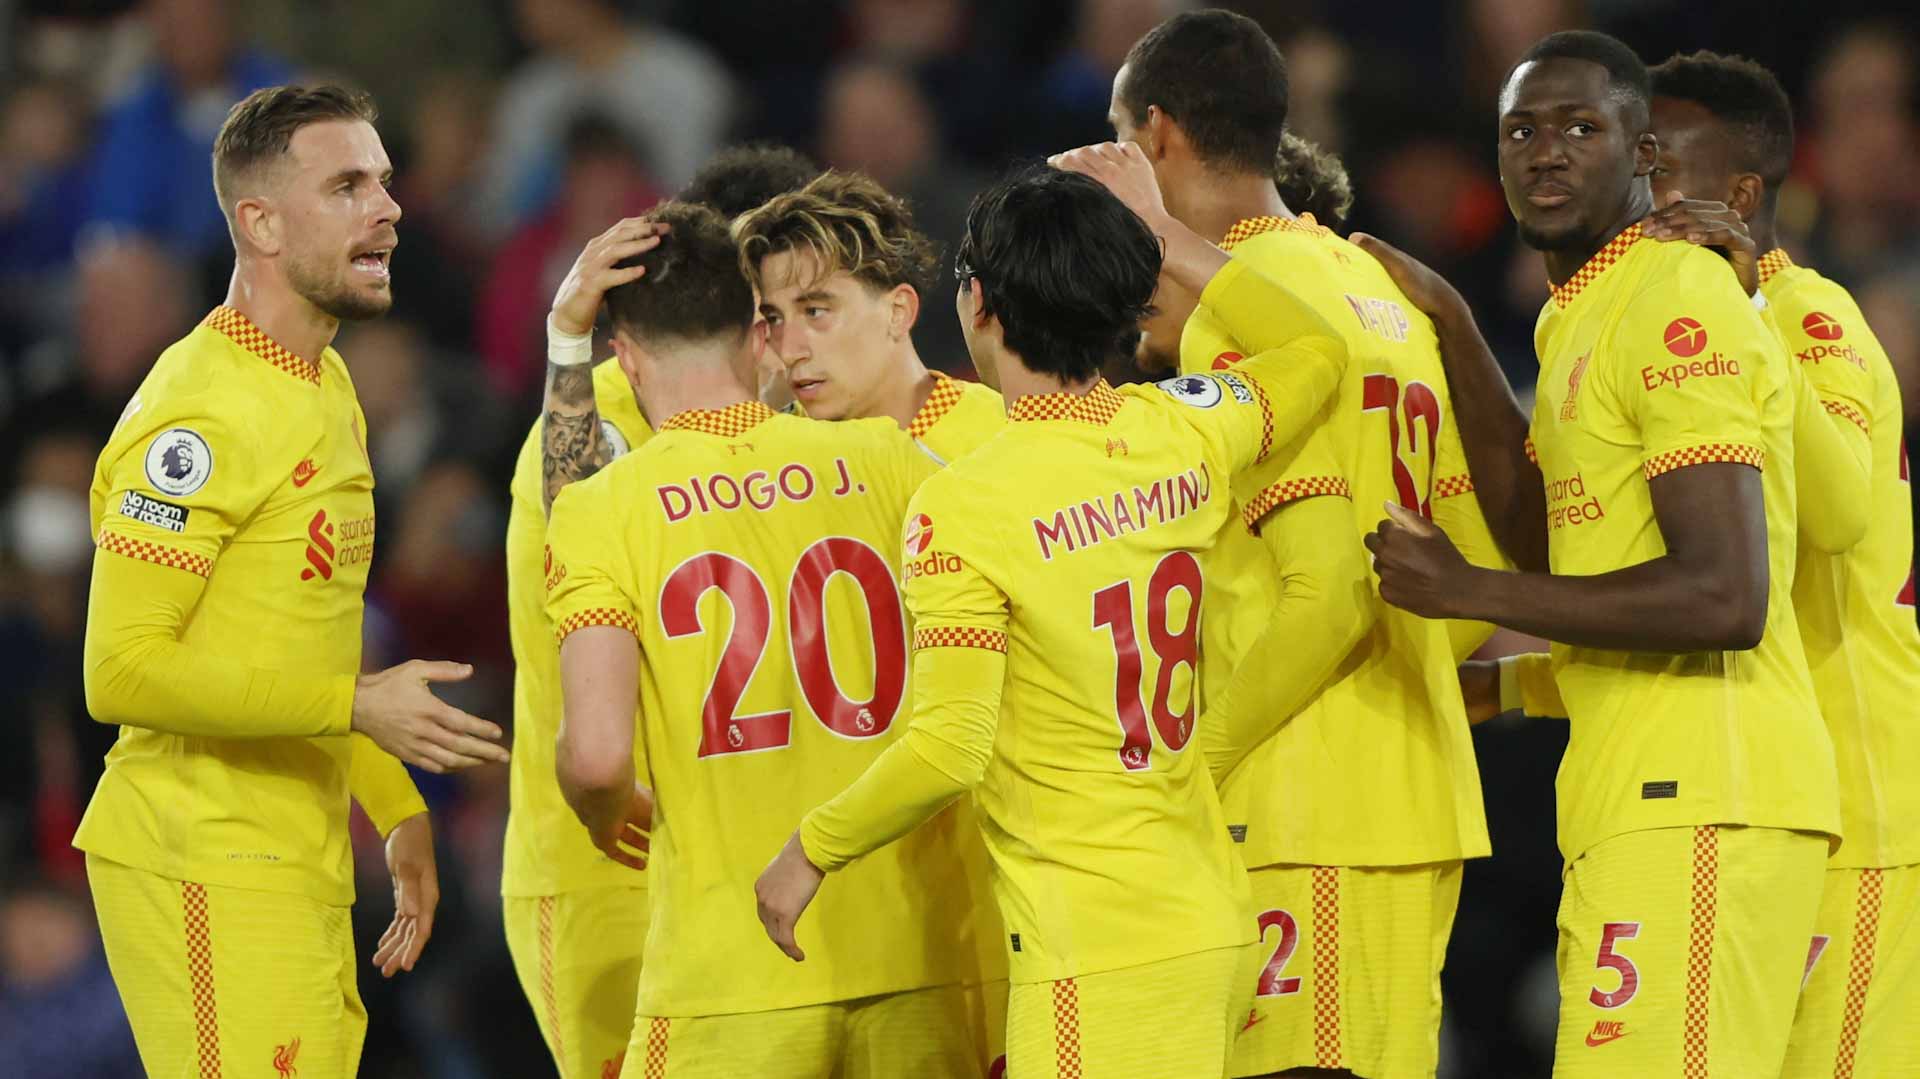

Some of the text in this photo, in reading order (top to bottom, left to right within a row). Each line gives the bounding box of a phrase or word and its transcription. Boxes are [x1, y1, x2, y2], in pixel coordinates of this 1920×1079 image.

[1640, 352, 1740, 392] Expedia
[1795, 344, 1867, 373] xpedia
[123, 490, 182, 519] No room
[657, 457, 867, 523] DIOGO J.
[120, 504, 185, 533] for racism
[1033, 461, 1210, 560] MINAMINO
[546, 562, 567, 591] edia
[903, 550, 962, 587] pedia
[659, 536, 908, 758] 20
[1091, 550, 1203, 771] 18
[1589, 921, 1641, 1010] 5
